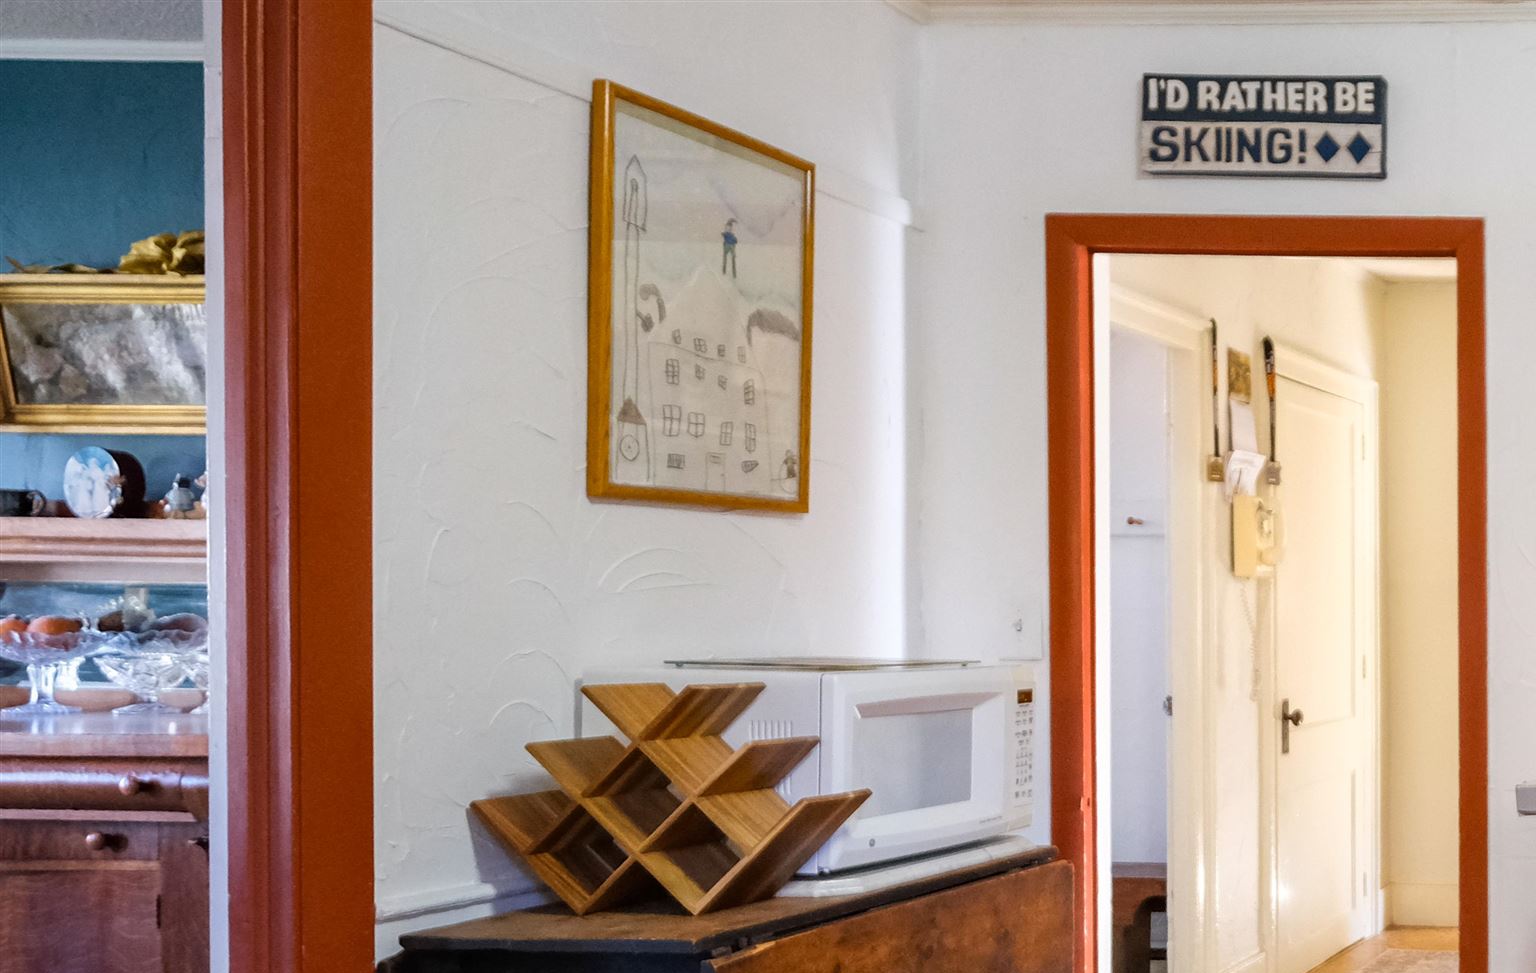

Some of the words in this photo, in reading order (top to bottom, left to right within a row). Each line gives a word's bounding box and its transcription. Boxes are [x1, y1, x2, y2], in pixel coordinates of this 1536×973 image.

[1147, 78, 1190, 110] I'D
[1197, 80, 1328, 113] RATHER
[1334, 81, 1375, 113] BE
[1150, 126, 1307, 164] SKIING!
